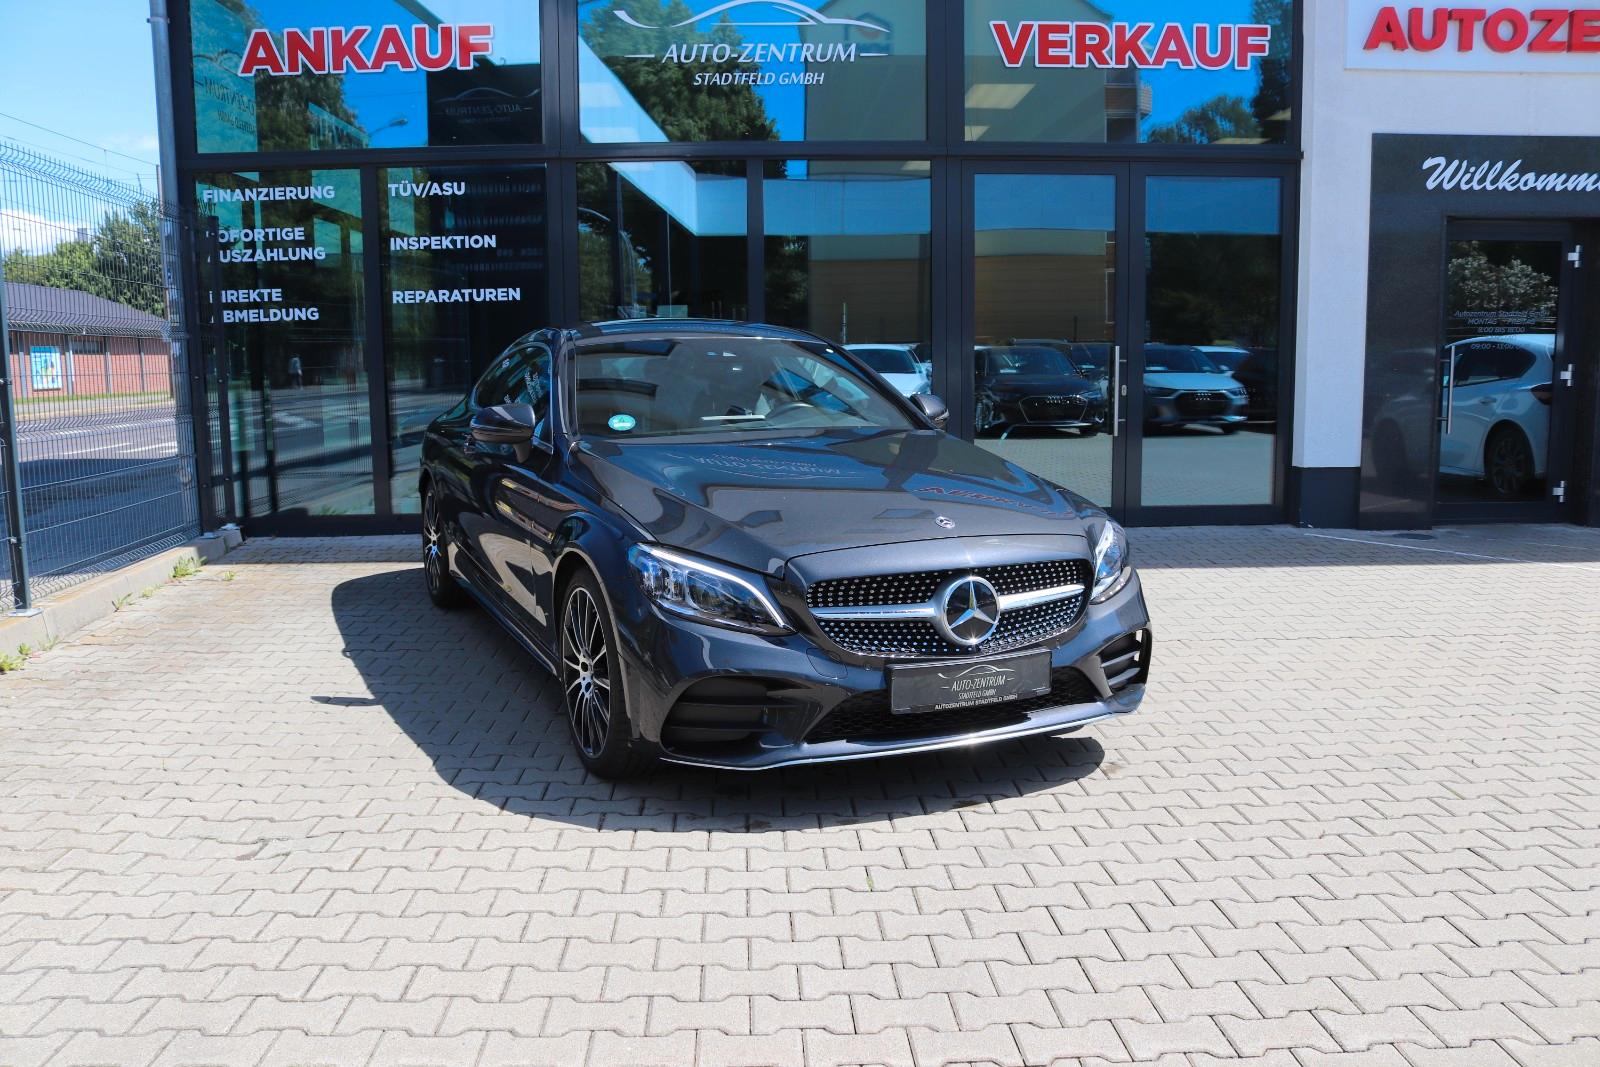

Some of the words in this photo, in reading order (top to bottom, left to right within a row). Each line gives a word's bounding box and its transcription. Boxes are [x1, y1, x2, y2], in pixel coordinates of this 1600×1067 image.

[1363, 7, 1600, 53] AUTOZE
[237, 23, 494, 77] ANKAUF
[662, 43, 857, 64] AUTO-ZENTRUM
[989, 20, 1271, 71] VERKAUF
[693, 72, 777, 86] STADTFELD
[778, 71, 825, 85] GMBH
[1421, 156, 1600, 192] Willkomm
[203, 185, 335, 203] FINANZIERUNG
[388, 180, 466, 198] TÜV/ASU
[206, 227, 305, 243] OFORTIGE
[390, 234, 497, 251] INSPEKTION
[208, 246, 326, 263] USZAHLUNG
[209, 288, 283, 304] IREKTE
[392, 287, 521, 304] REPARATUREN
[210, 307, 320, 324] BMELDUNG
[951, 675, 1006, 692] AUTO-ZENTRUM
